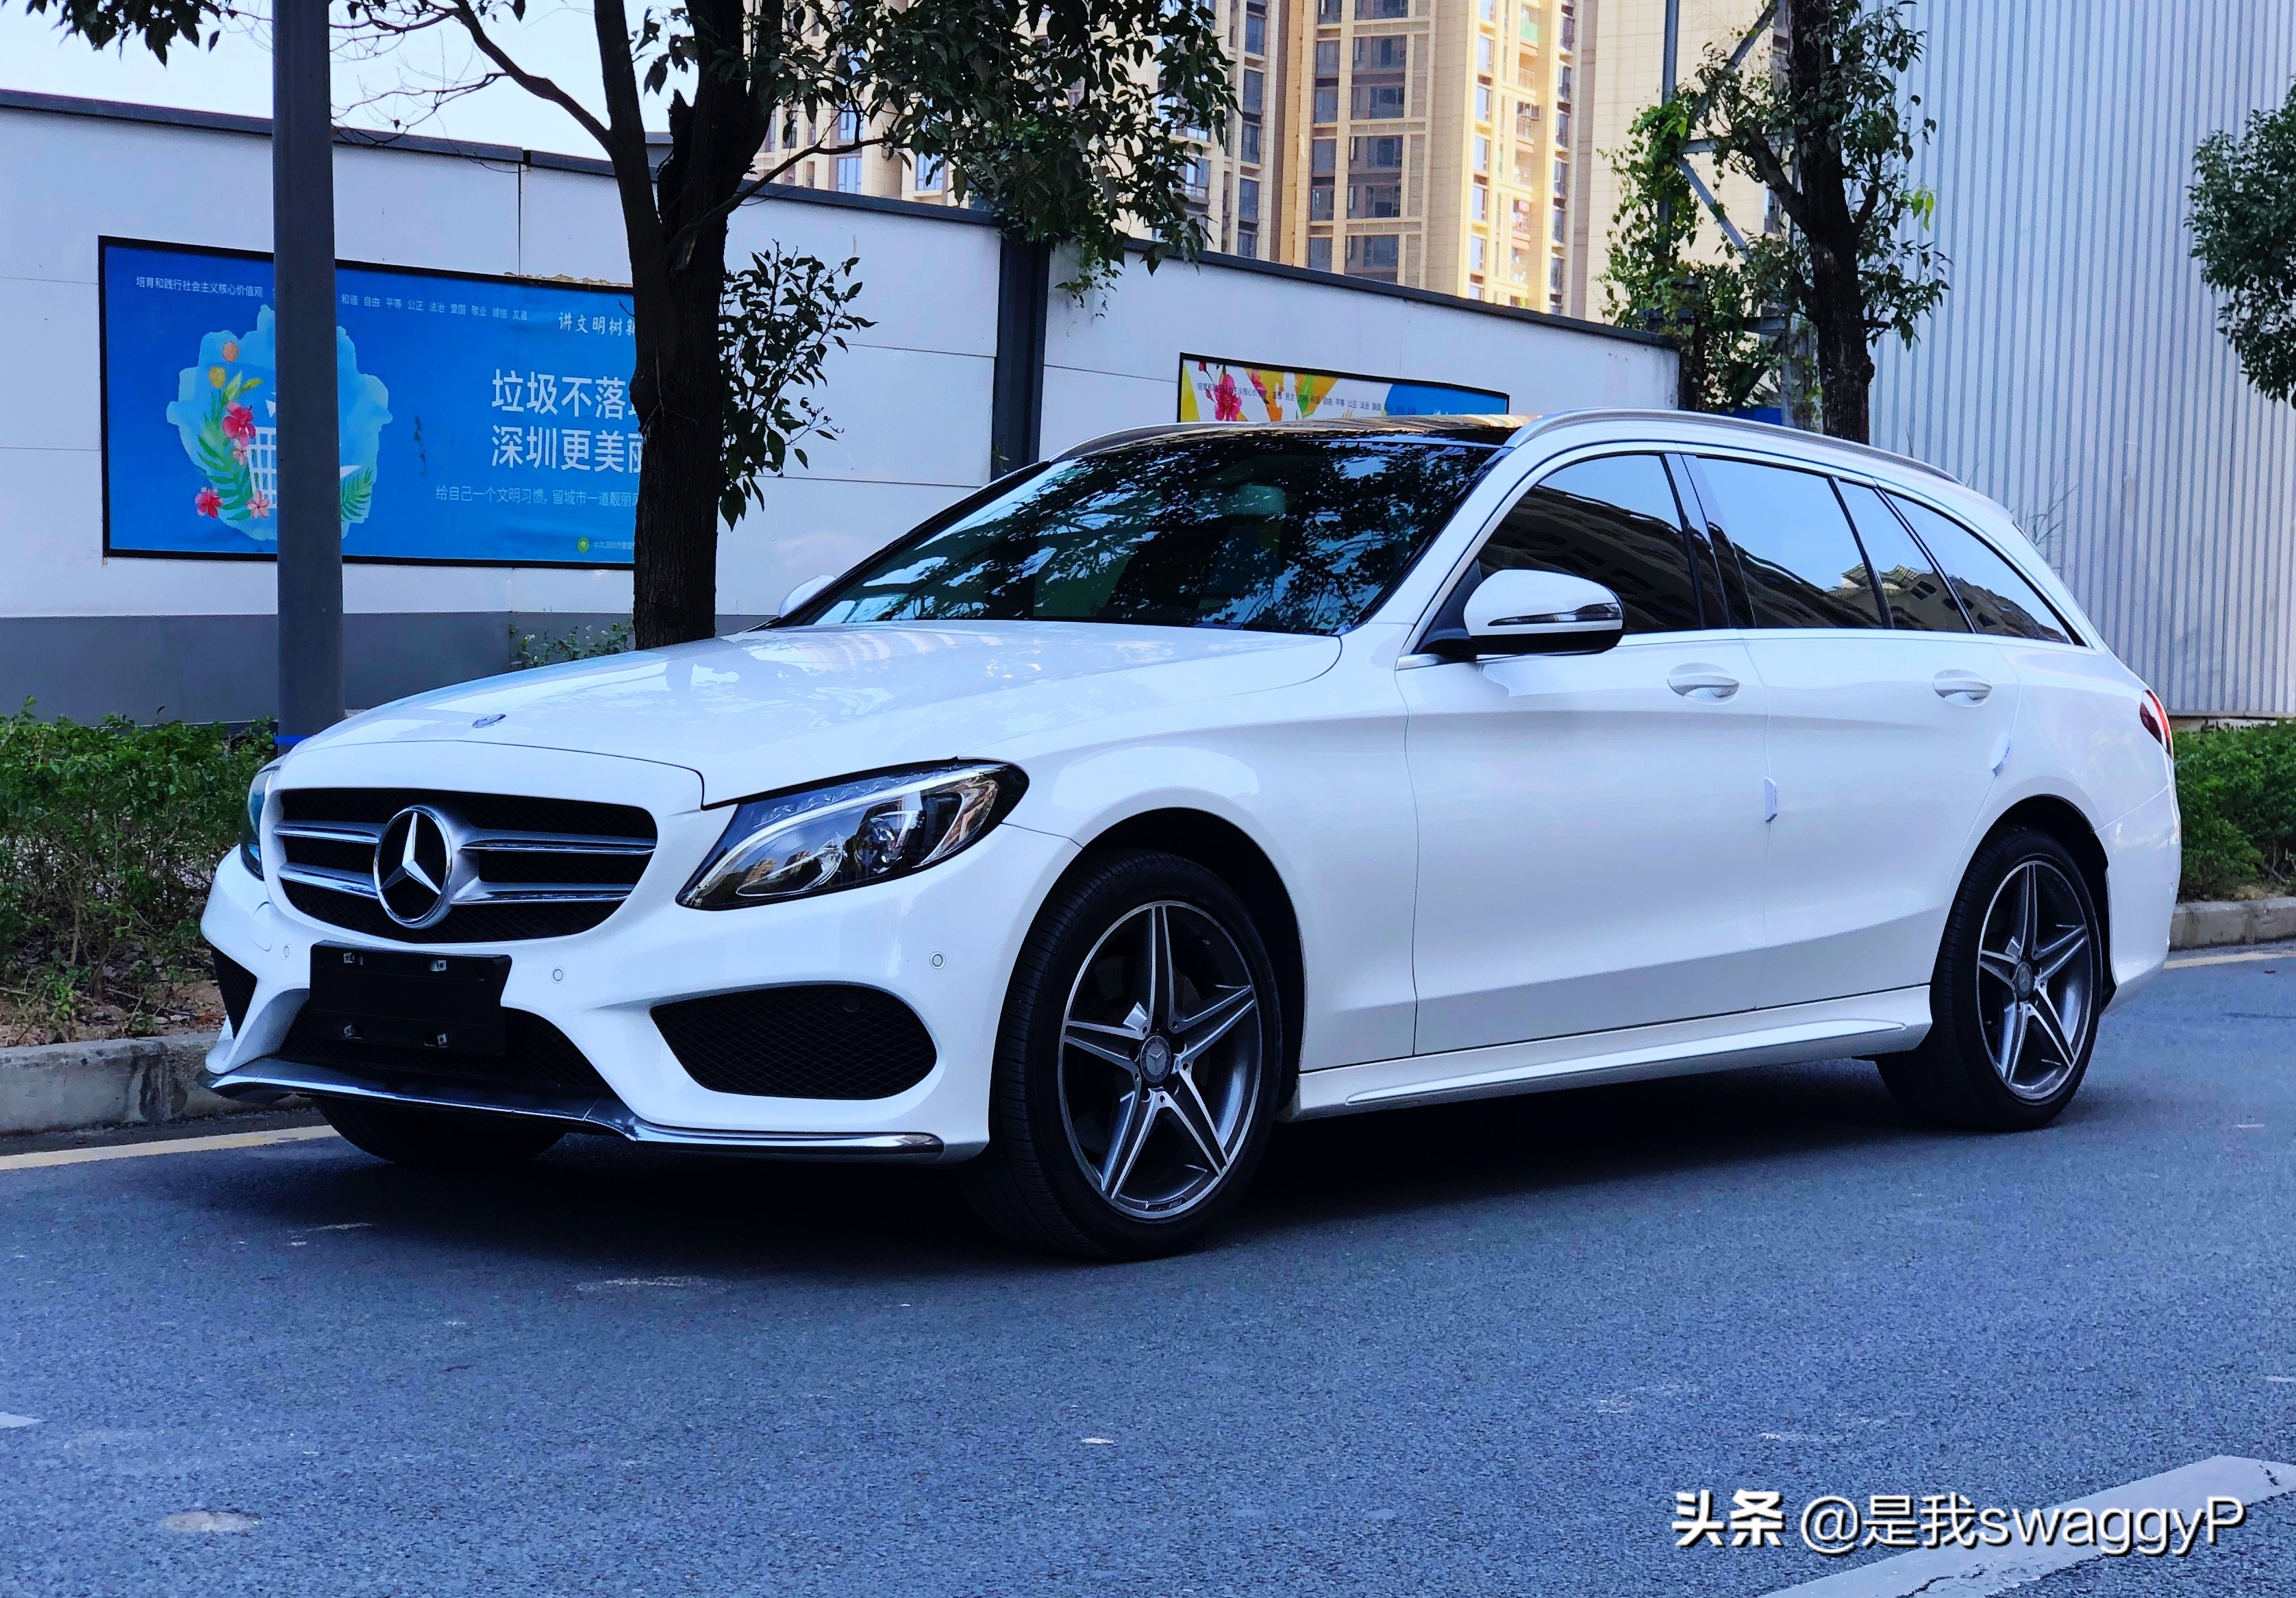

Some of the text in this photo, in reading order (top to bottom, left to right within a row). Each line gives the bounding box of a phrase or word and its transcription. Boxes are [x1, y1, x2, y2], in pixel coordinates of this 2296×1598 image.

[136, 275, 264, 297] 培育和践行社会主义核心价值观
[341, 294, 358, 305] 和谐
[364, 296, 380, 308] 自由
[386, 297, 402, 309] 平等
[408, 299, 423, 312] 公正
[429, 301, 445, 314] 法治
[450, 303, 466, 315] 爱国
[492, 369, 636, 420] 垃圾不落
